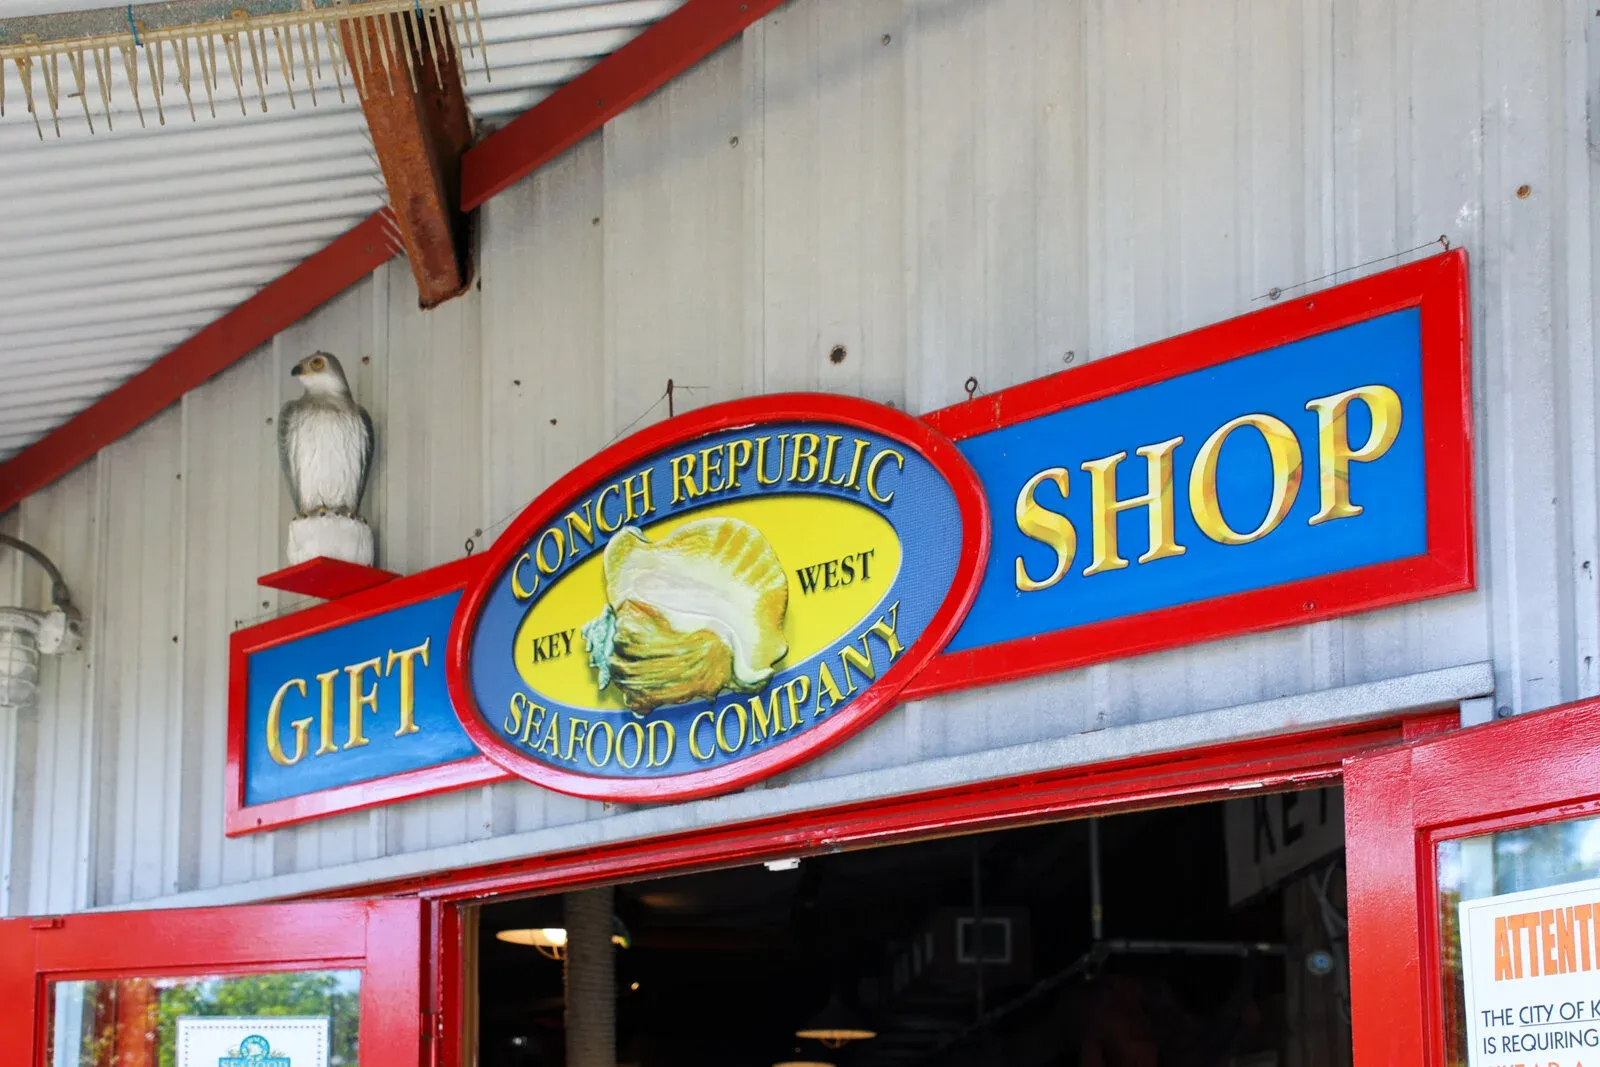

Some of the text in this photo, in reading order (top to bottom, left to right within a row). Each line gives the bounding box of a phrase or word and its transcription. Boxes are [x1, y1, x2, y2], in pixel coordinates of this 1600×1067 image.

[511, 432, 905, 601] CONCH REPUBLIC
[1014, 384, 1403, 592] SHOP
[796, 548, 876, 596] WEST
[503, 601, 906, 770] SEAFOOD COMPANY
[531, 627, 577, 664] KEY
[266, 636, 430, 767] GIFT
[1481, 1008, 1515, 1028] THE
[1519, 1004, 1554, 1025] CITY
[1559, 1001, 1585, 1021] OF
[1483, 1028, 1600, 1054] IS REQUIRING
